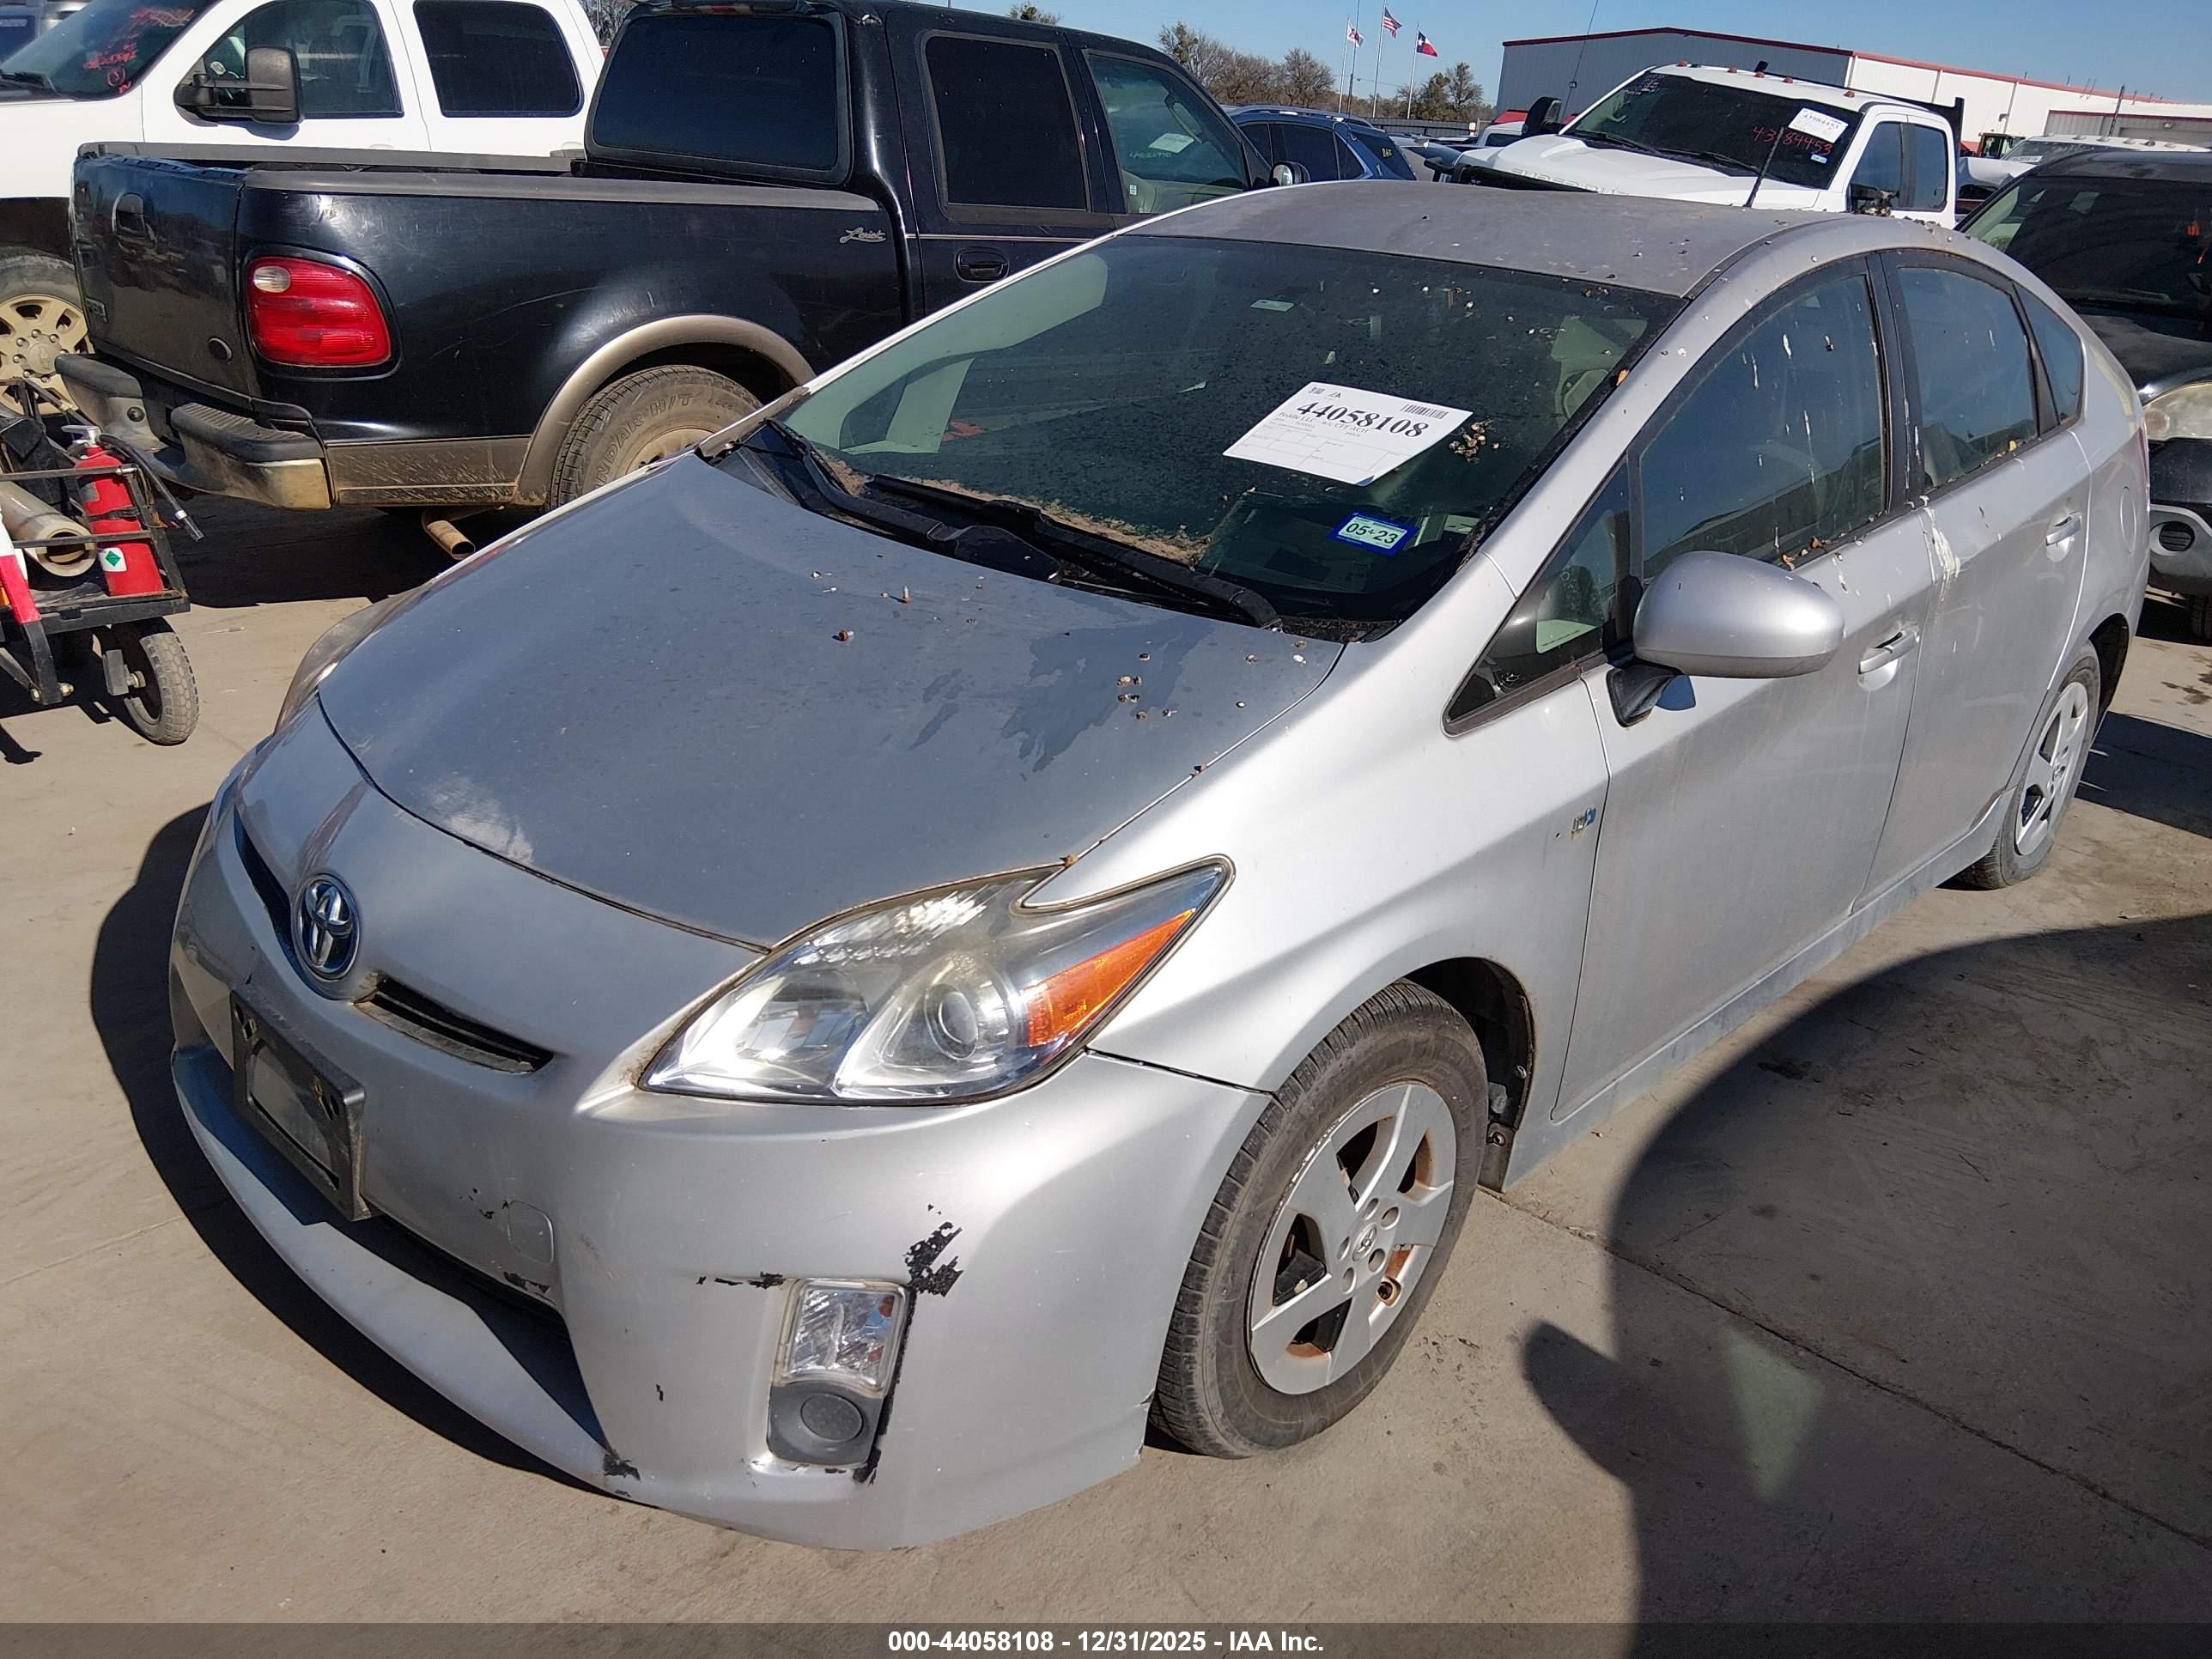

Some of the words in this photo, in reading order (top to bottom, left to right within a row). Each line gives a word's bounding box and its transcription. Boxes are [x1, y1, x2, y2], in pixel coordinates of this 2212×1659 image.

[1753, 126, 1834, 155] 4384453
[1297, 401, 1430, 438] 44058108
[1346, 523, 1371, 536] 05
[1372, 530, 1398, 544] 23
